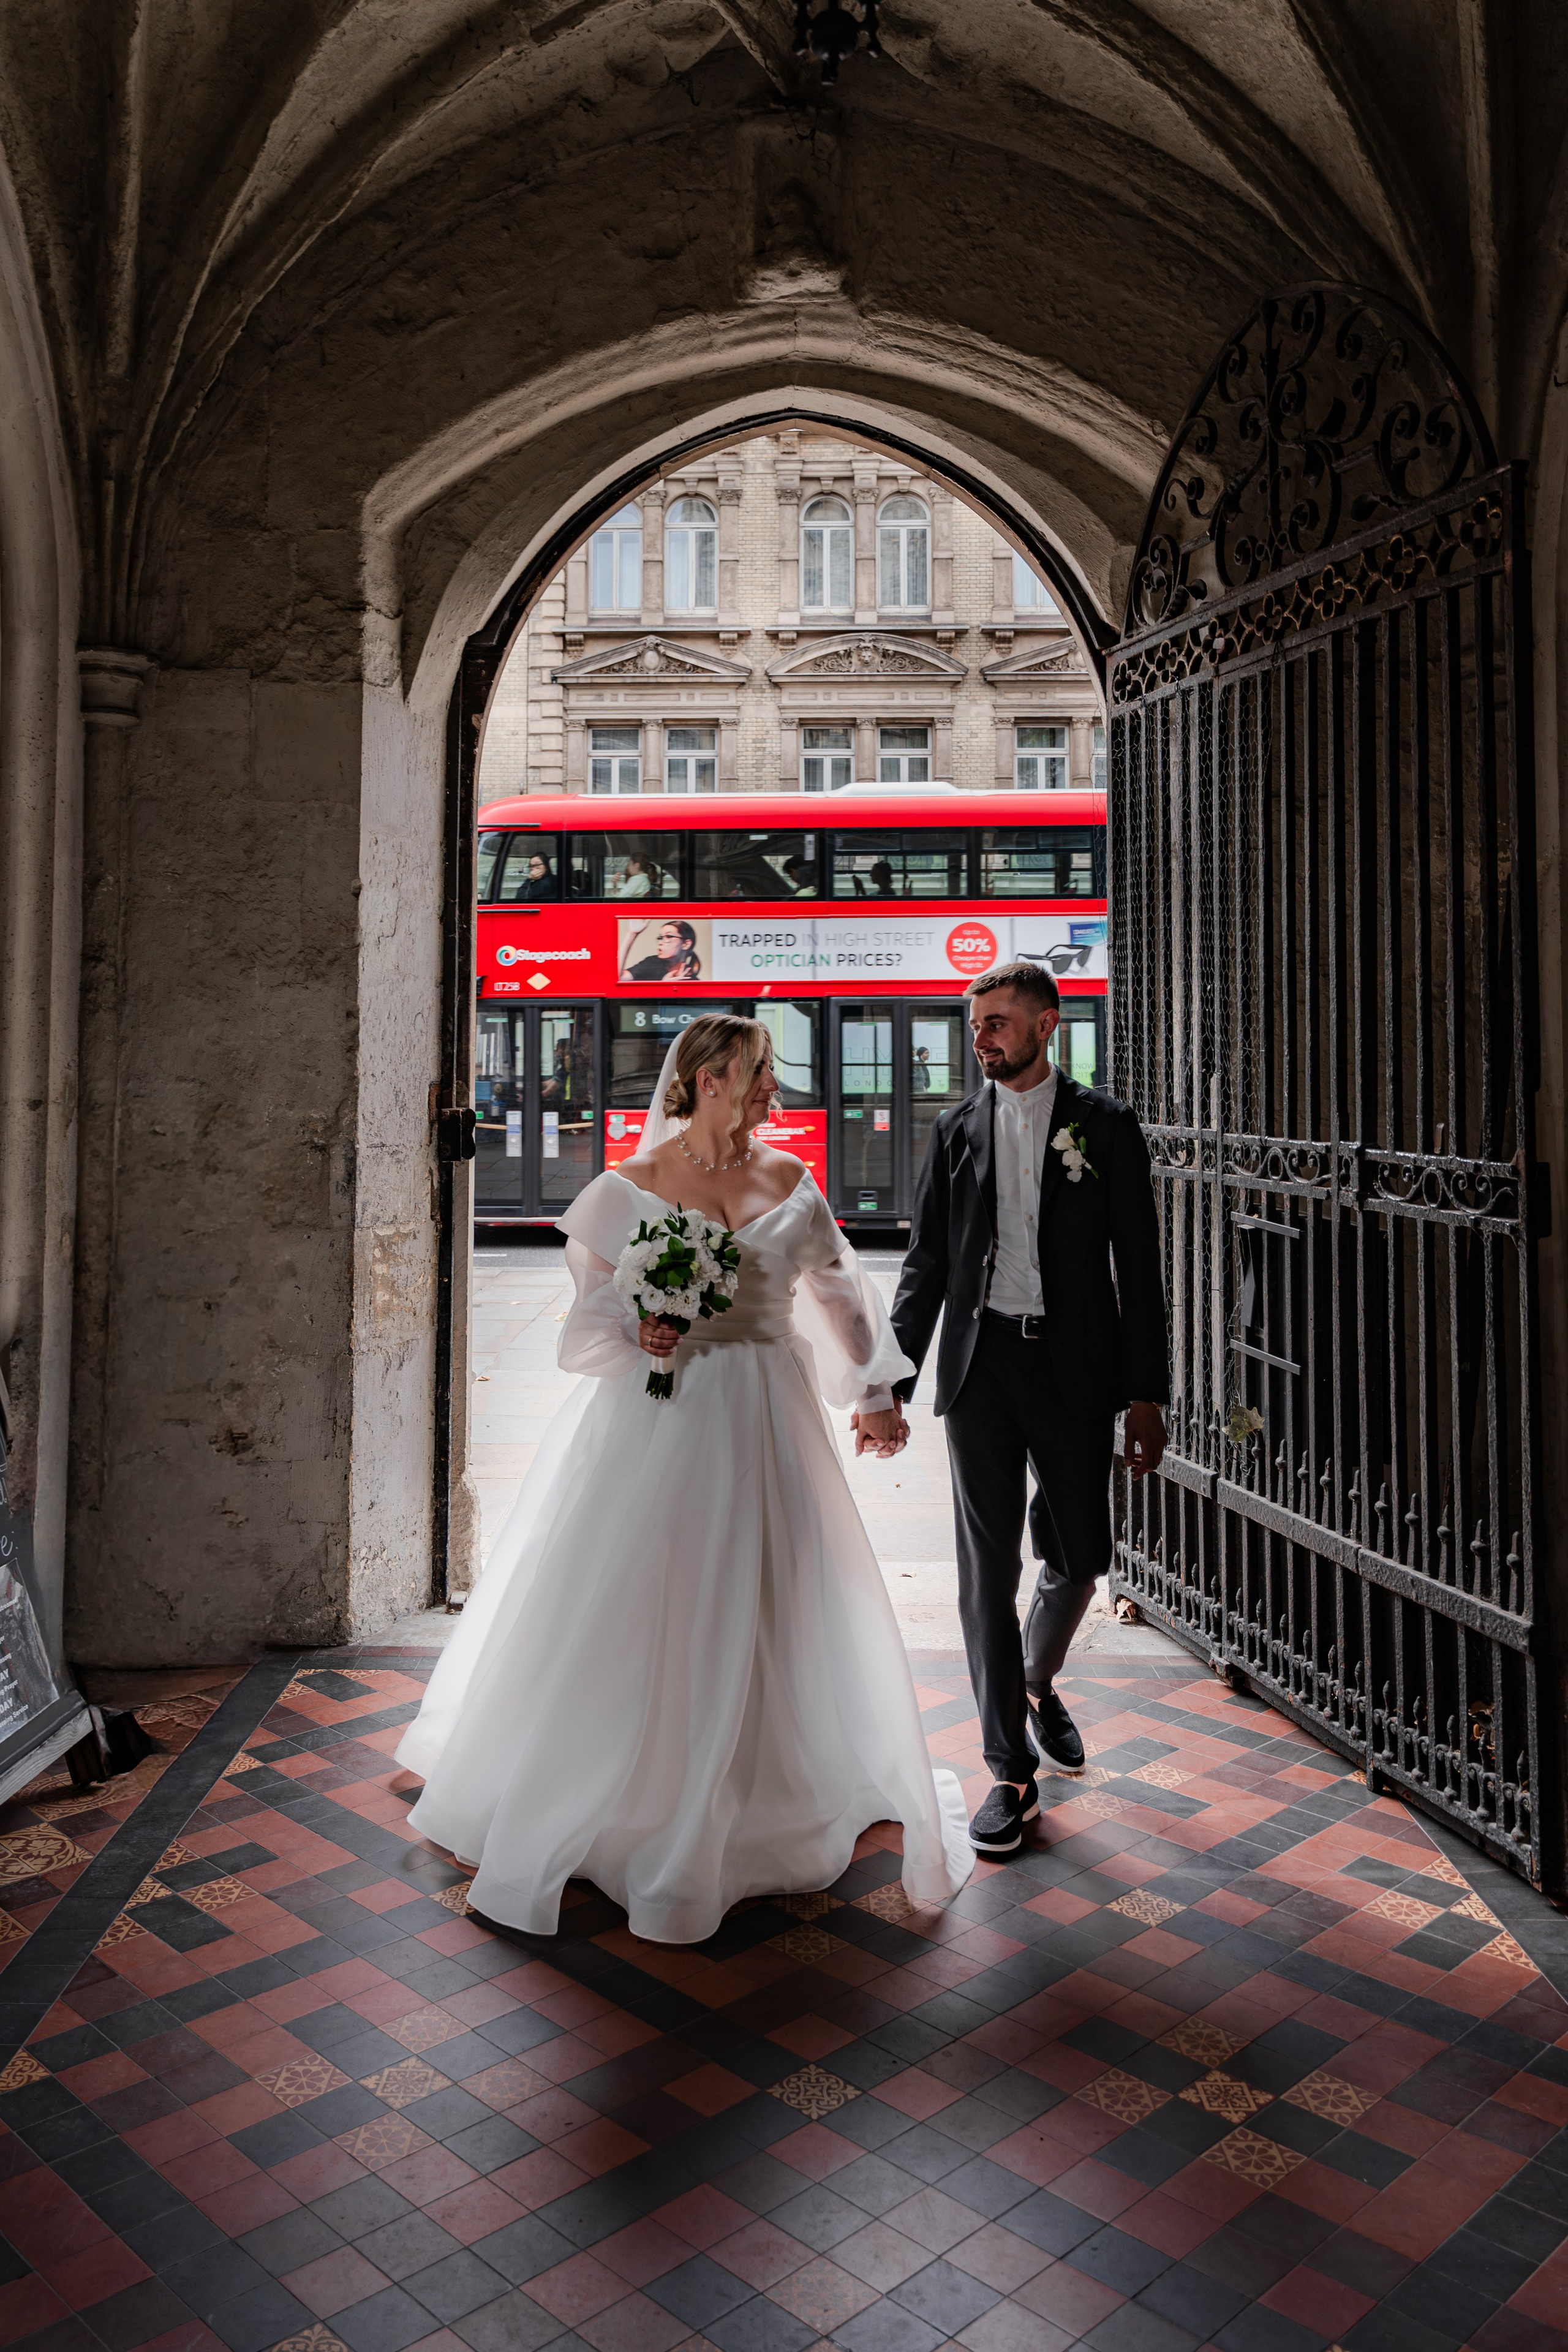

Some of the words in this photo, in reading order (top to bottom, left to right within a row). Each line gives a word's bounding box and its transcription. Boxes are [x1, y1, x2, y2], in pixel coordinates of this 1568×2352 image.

[718, 933, 797, 948] TRAPPED
[802, 933, 819, 946] IN
[826, 932, 868, 946] HIGH
[873, 932, 935, 946] STREET
[952, 938, 991, 952] 50%
[516, 948, 591, 963] Stagecoach
[750, 954, 831, 968] OPTICIAN
[837, 953, 902, 967] PRICES?
[634, 1011, 646, 1027] 8
[652, 1014, 676, 1024] Bow
[4, 1679, 18, 1692] Prayer
[13, 1704, 29, 1717] Service
